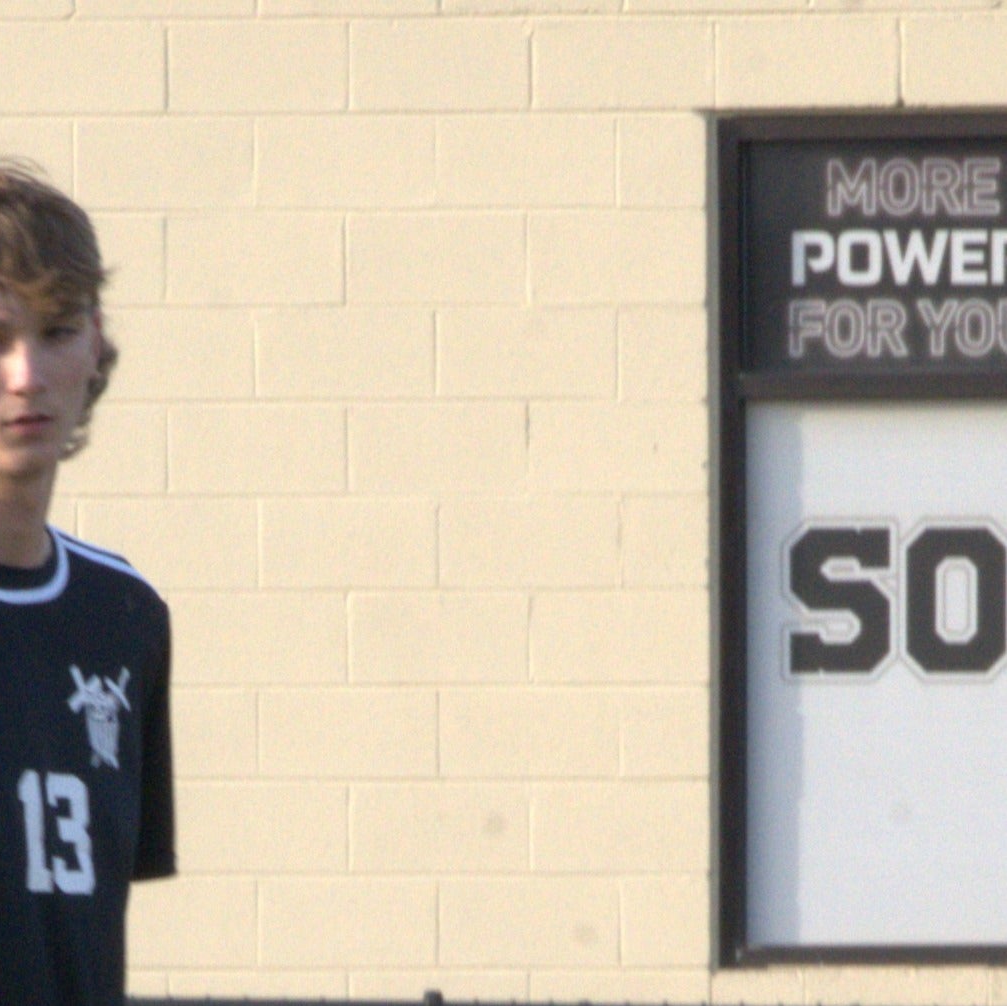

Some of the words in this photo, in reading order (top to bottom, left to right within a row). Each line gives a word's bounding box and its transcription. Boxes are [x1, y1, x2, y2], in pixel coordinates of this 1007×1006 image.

[826, 157, 1001, 216] MORE
[788, 298, 908, 358] FOR
[917, 298, 1007, 358] YO
[17, 769, 96, 895] 13
